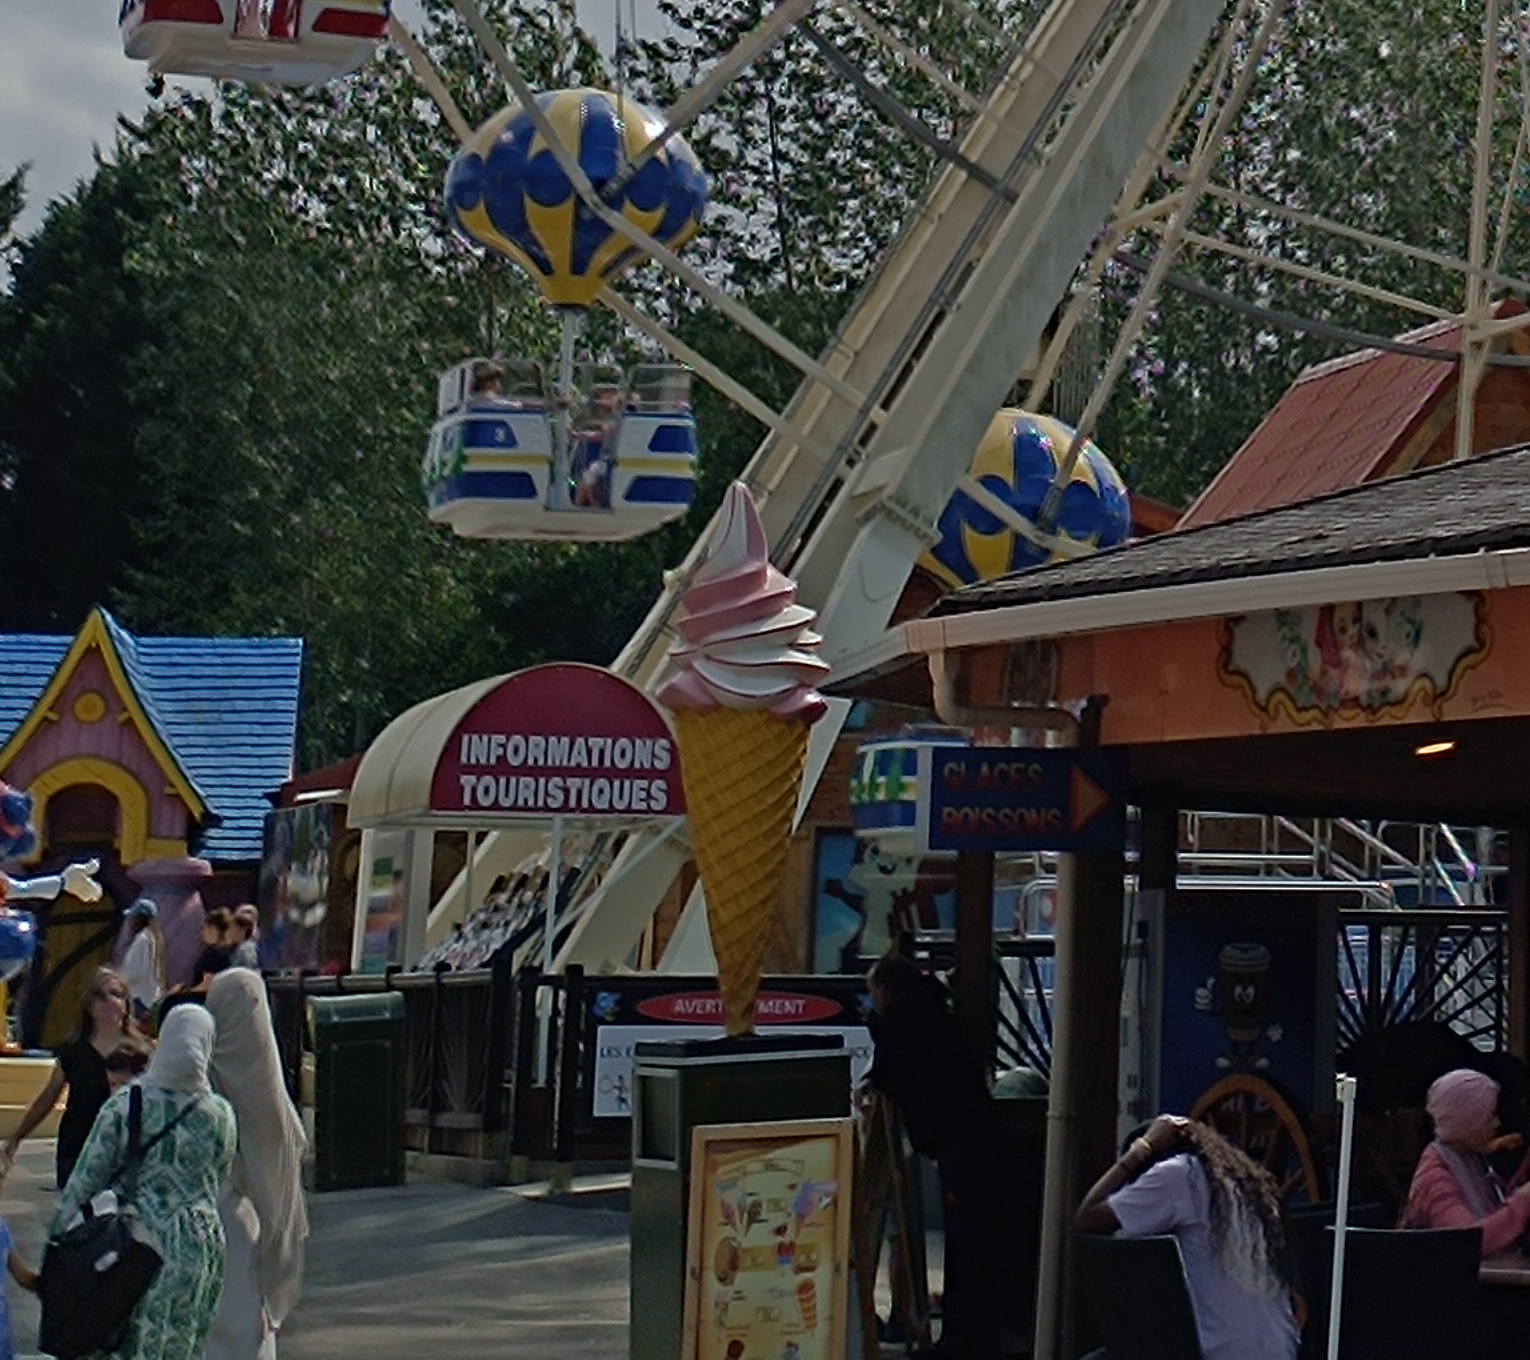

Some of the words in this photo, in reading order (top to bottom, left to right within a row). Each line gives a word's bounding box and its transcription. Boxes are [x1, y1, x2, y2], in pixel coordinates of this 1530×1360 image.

[460, 733, 672, 771] INFORMATIONS
[459, 774, 668, 811] TOURISTIQUES
[942, 761, 1044, 791] GLACES
